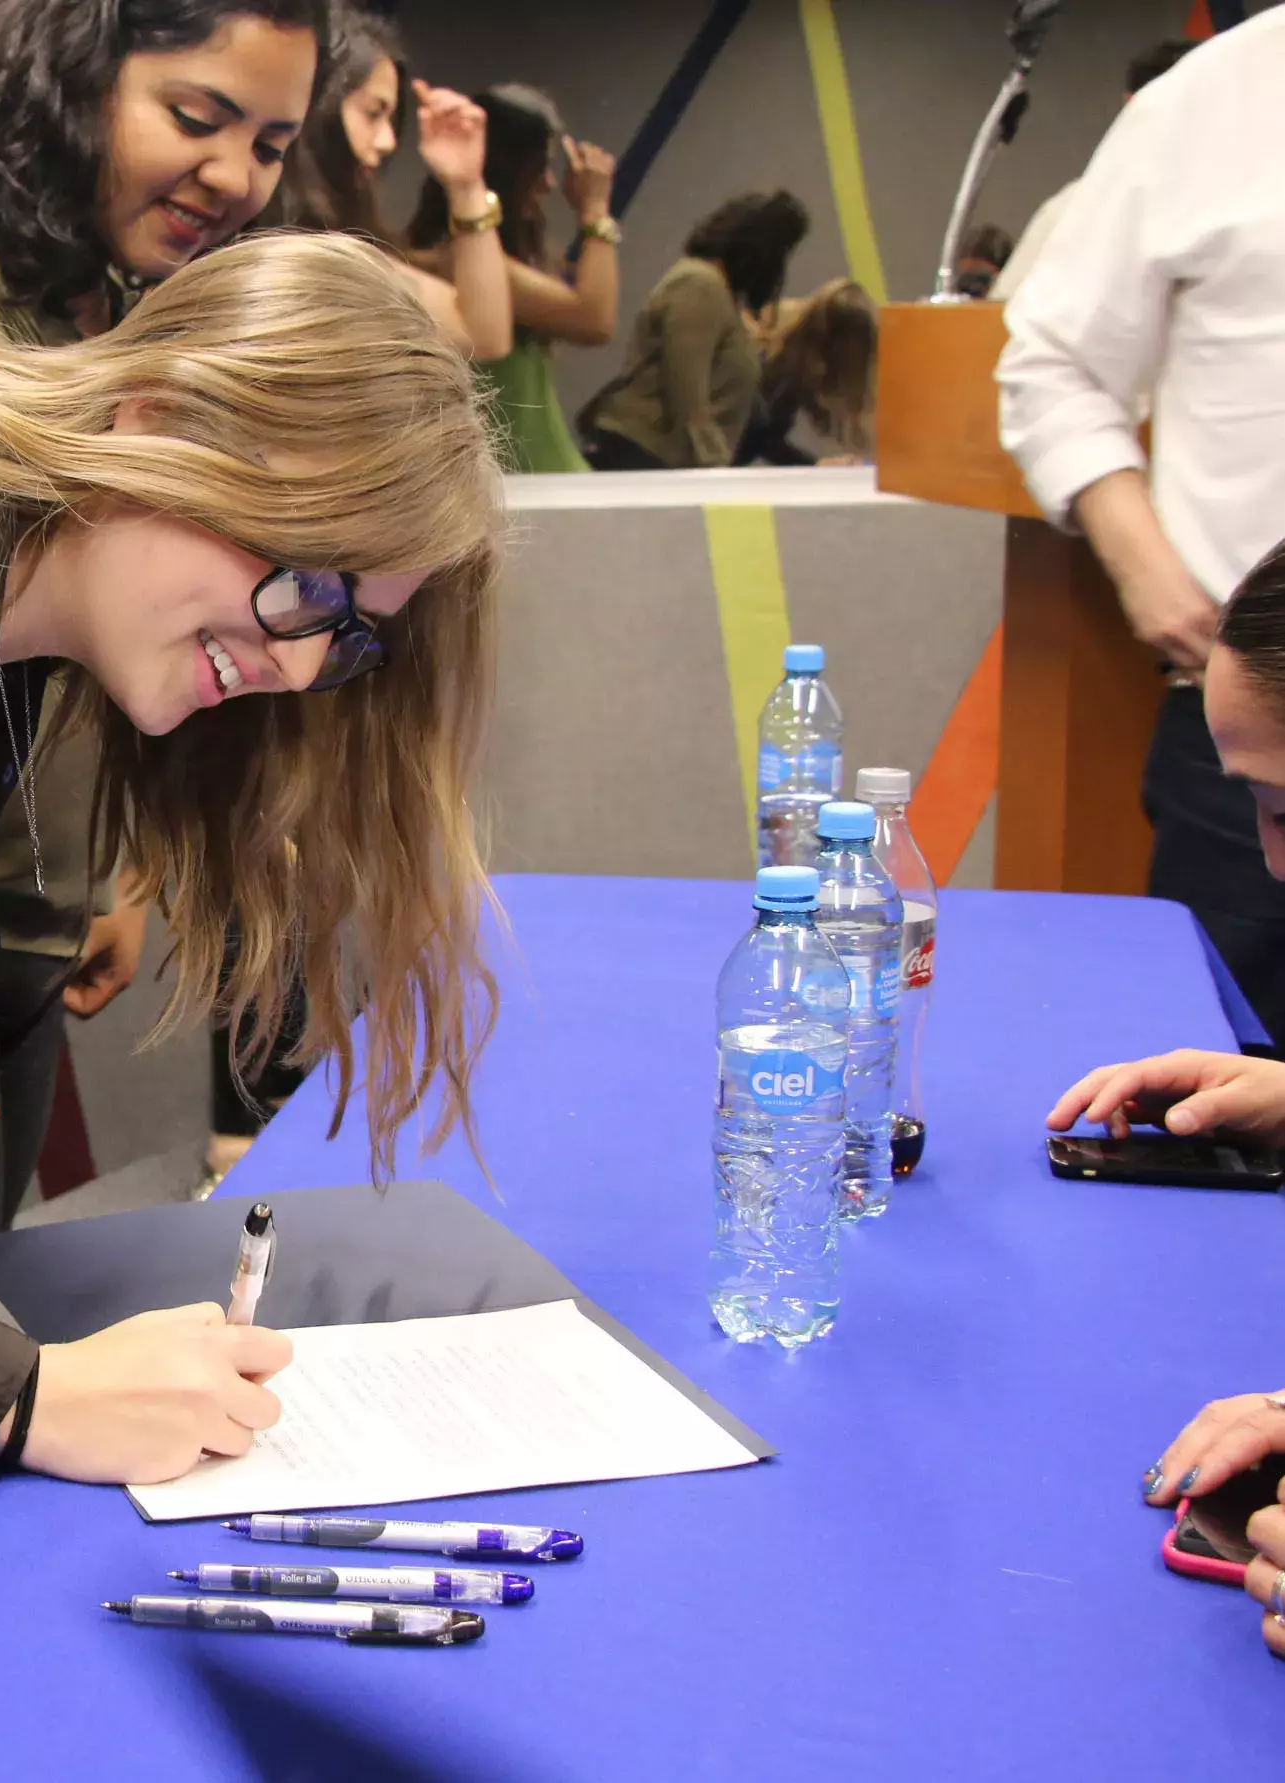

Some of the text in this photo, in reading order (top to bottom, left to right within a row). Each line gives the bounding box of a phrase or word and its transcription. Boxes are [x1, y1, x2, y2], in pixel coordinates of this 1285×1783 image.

[752, 1065, 814, 1097] ciel
[281, 1573, 322, 1584] Roller Ball
[240, 1619, 256, 1628] Ball
